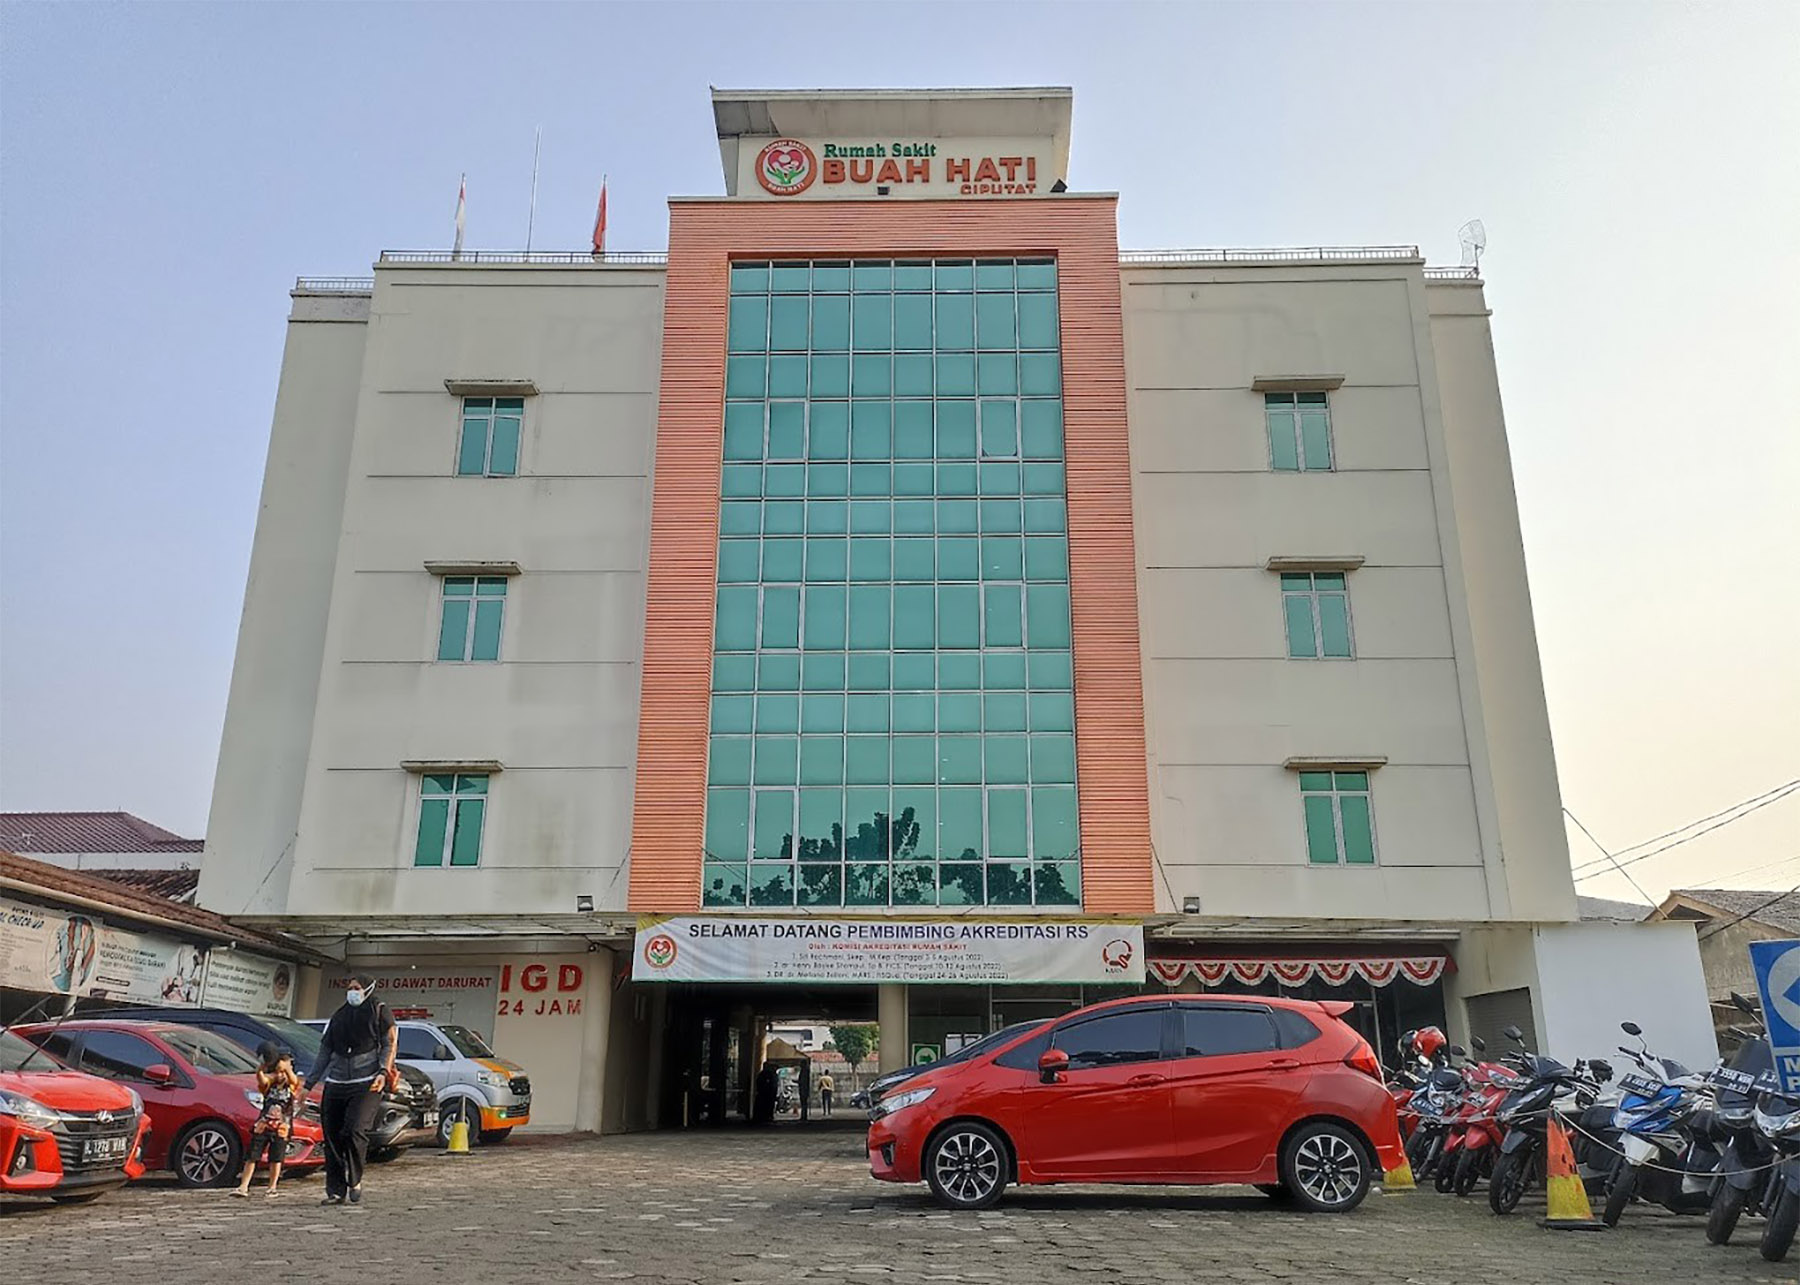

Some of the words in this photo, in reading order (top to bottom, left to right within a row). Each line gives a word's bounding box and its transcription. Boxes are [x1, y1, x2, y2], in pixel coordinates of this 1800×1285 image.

[824, 143, 886, 158] Rumah
[892, 142, 936, 158] Sakit
[823, 159, 930, 183] BUAH
[946, 157, 1035, 182] HATI
[960, 183, 1036, 194] CIPUTAT
[689, 925, 768, 938] SELAMAT
[773, 925, 841, 939] DATANG
[848, 925, 956, 939] PEMBIMBING
[961, 926, 1059, 939] AKREDITASI
[1067, 926, 1088, 938] RS
[863, 943, 910, 951] AKREDITASI
[912, 943, 941, 951] RUMAH
[943, 943, 967, 951] SAKIT
[393, 978, 436, 990] GAWAT
[438, 978, 492, 988] DARURAT
[501, 964, 583, 992] IGD
[498, 1000, 523, 1015] 24
[535, 1000, 581, 1015] JAM
